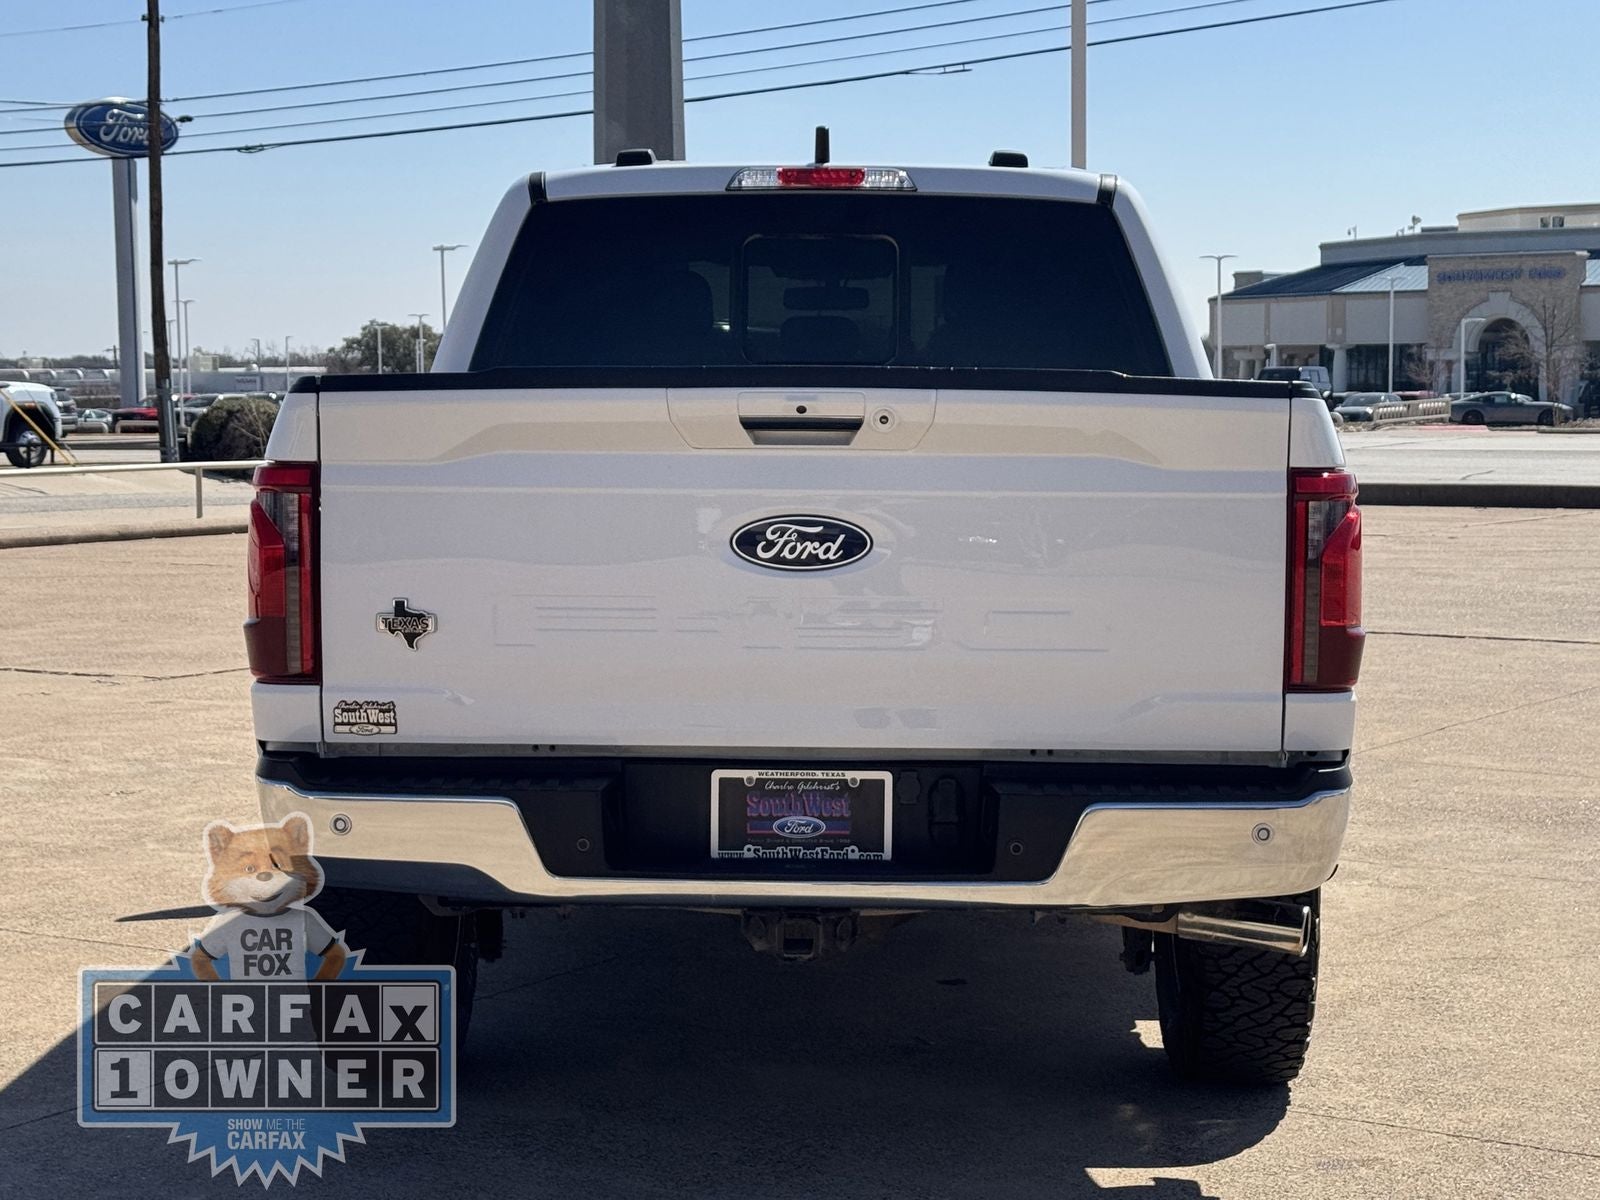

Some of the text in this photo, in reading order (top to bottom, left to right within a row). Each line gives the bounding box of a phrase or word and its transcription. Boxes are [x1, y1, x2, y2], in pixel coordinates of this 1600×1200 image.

[100, 108, 149, 144] For
[756, 523, 846, 560] Ford
[382, 617, 429, 629] TEXAS
[334, 708, 395, 723] SouthWest
[746, 792, 850, 817] SouthWest
[784, 819, 813, 834] Ford
